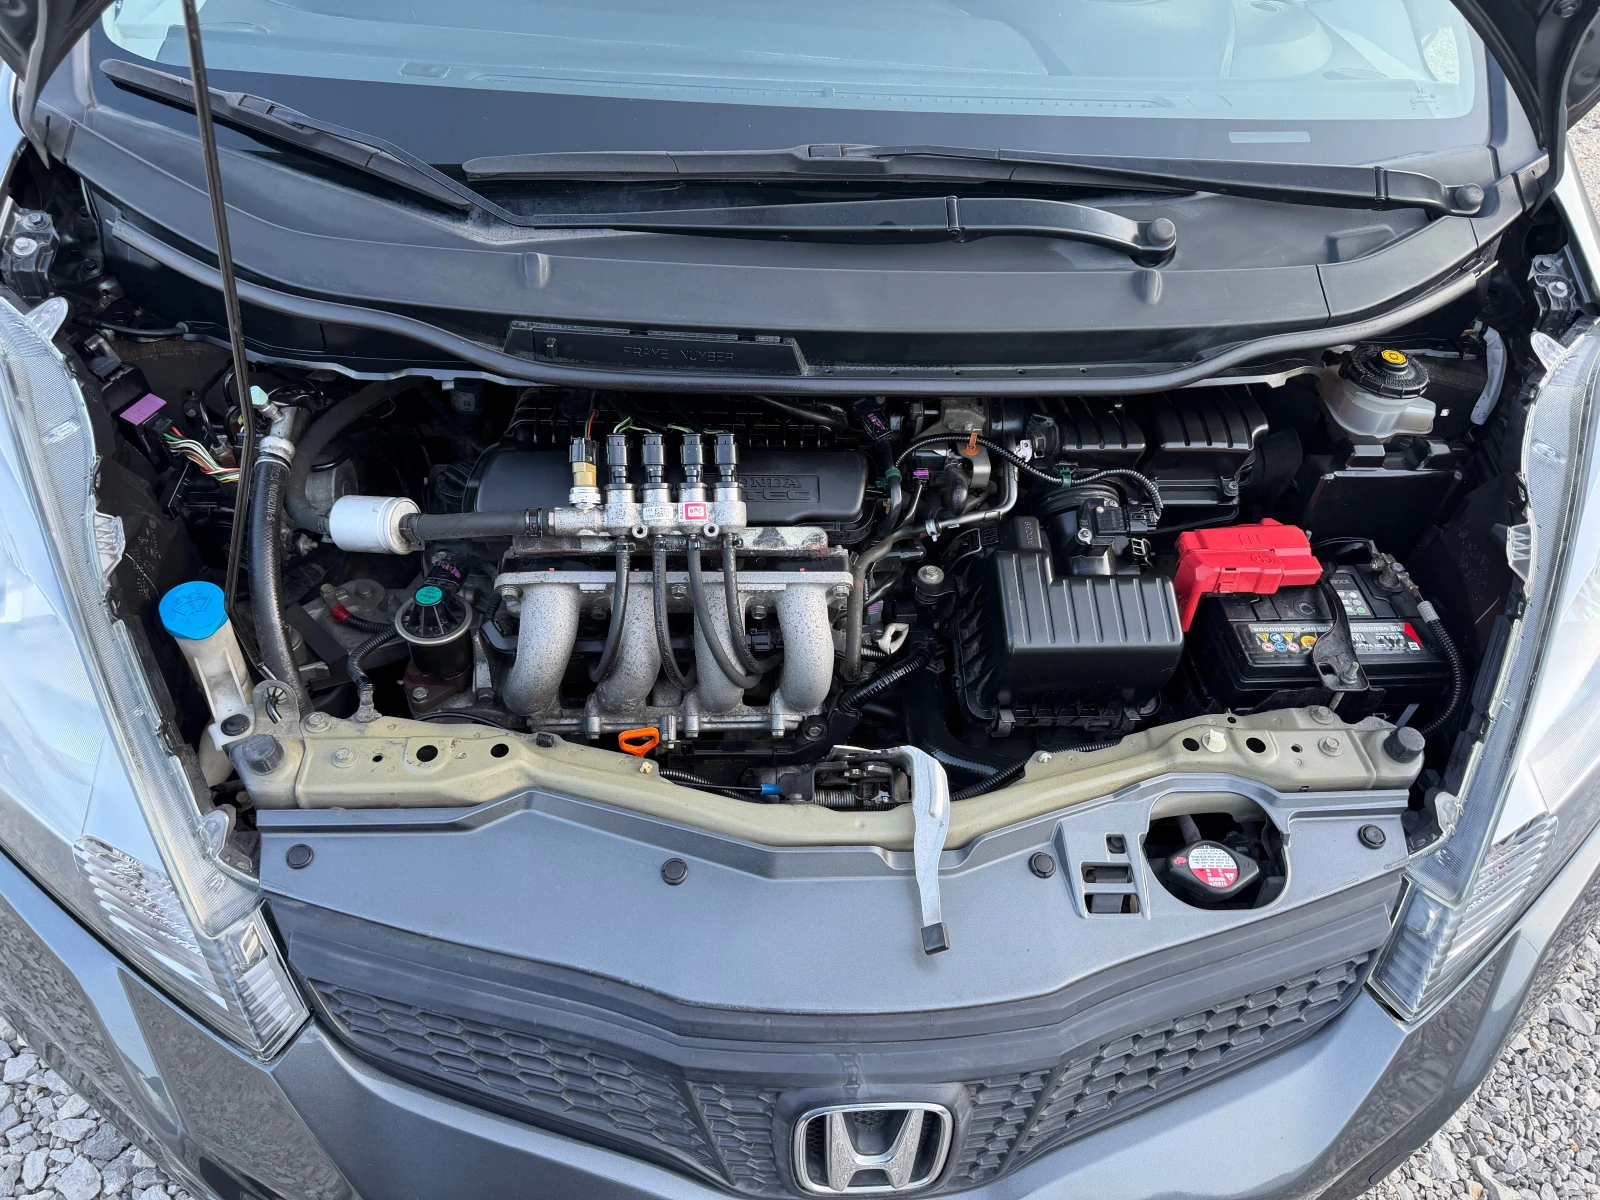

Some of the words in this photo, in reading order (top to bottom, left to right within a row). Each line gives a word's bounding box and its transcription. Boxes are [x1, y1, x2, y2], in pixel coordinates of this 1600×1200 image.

[623, 346, 669, 360] FRAME
[680, 350, 734, 362] NUMBER
[738, 477, 803, 489] ONDA
[740, 489, 812, 501] TEC
